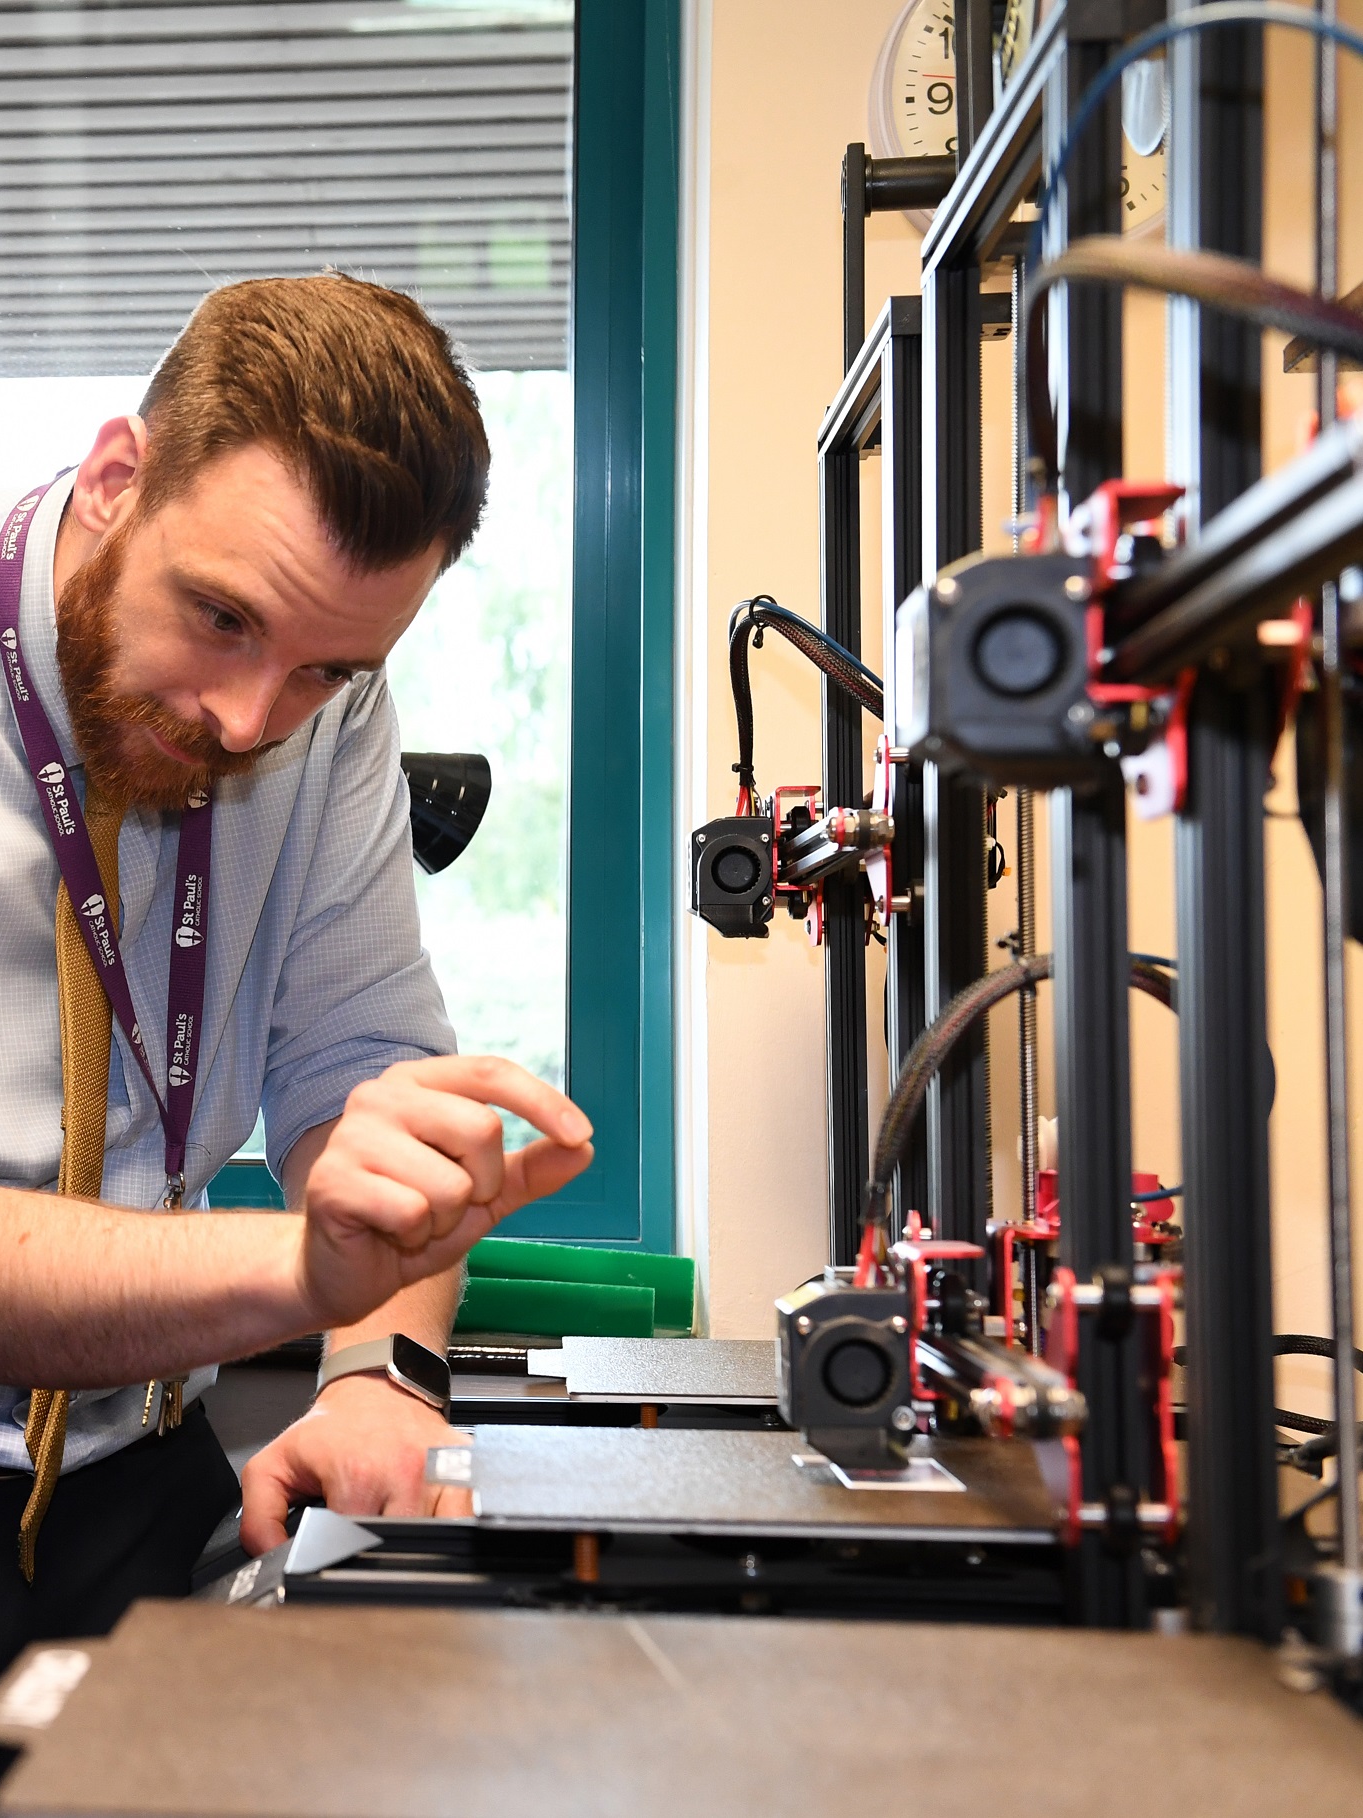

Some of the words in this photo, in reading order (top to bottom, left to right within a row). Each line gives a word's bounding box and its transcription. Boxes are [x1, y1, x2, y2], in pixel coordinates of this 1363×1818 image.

[927, 82, 954, 115] 9
[14, 511, 28, 523] St
[6, 524, 23, 560] Paul's
[10, 651, 18, 664] St
[13, 666, 30, 702] Paul's
[52, 784, 65, 798] St
[46, 787, 58, 814] CATHOLIC
[54, 813, 65, 837] SCHOOL
[56, 798, 76, 835] Paul's
[183, 874, 197, 910] Paul's
[94, 916, 105, 930] St
[182, 912, 194, 925] St
[99, 929, 116, 966] Paul's
[173, 1013, 187, 1049] Paul's
[186, 1015, 194, 1038] SCHOOL
[173, 1051, 184, 1065] St
[183, 1038, 192, 1066] CATHOLIC
